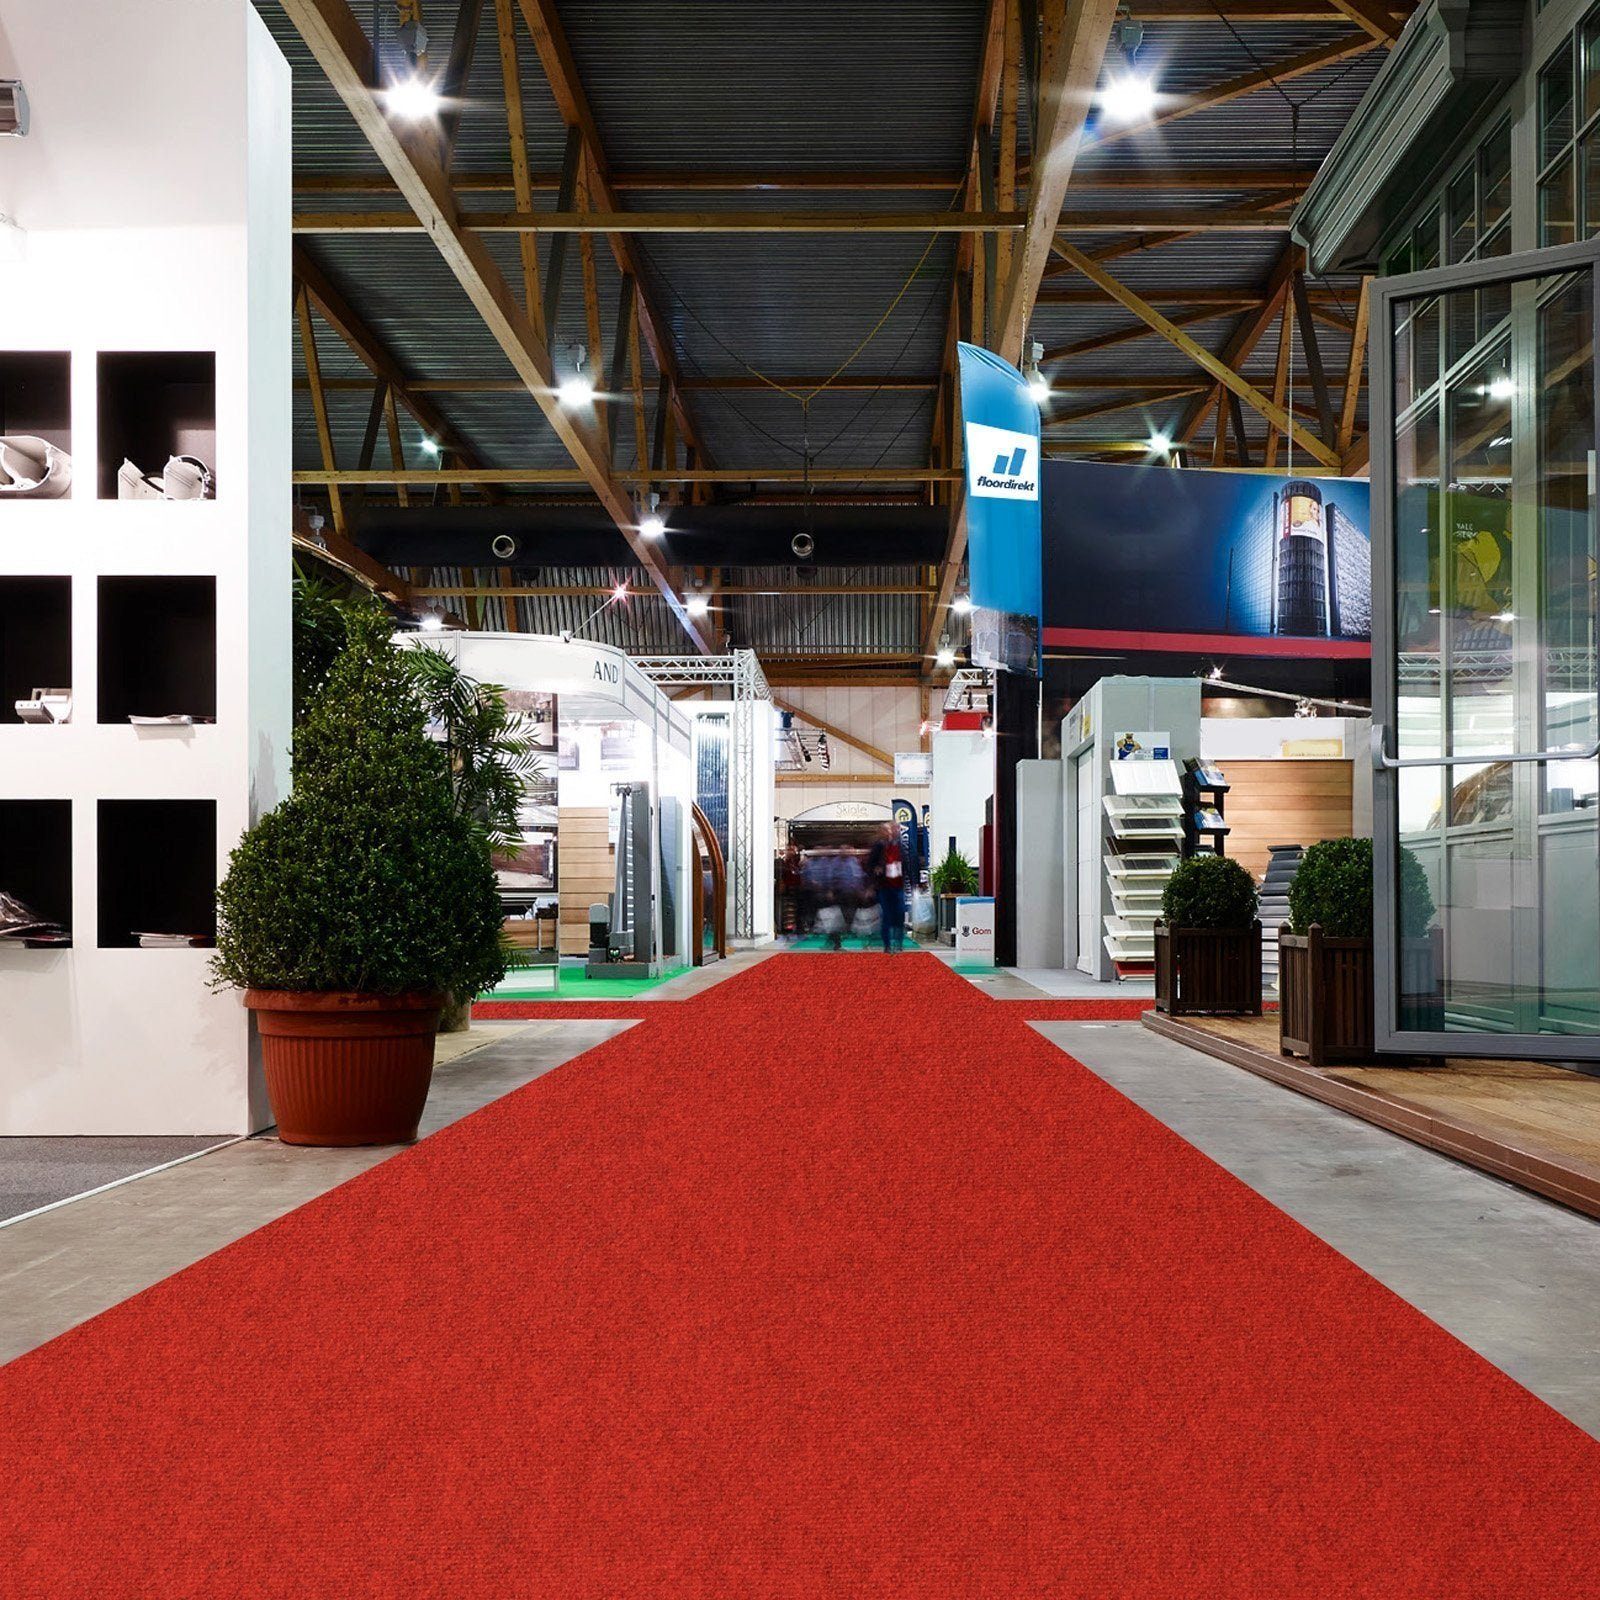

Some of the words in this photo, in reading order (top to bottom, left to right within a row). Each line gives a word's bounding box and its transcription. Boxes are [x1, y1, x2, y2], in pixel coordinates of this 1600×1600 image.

[977, 476, 1035, 491] floordirekt
[593, 660, 619, 684] AND
[971, 926, 992, 935] Gom
